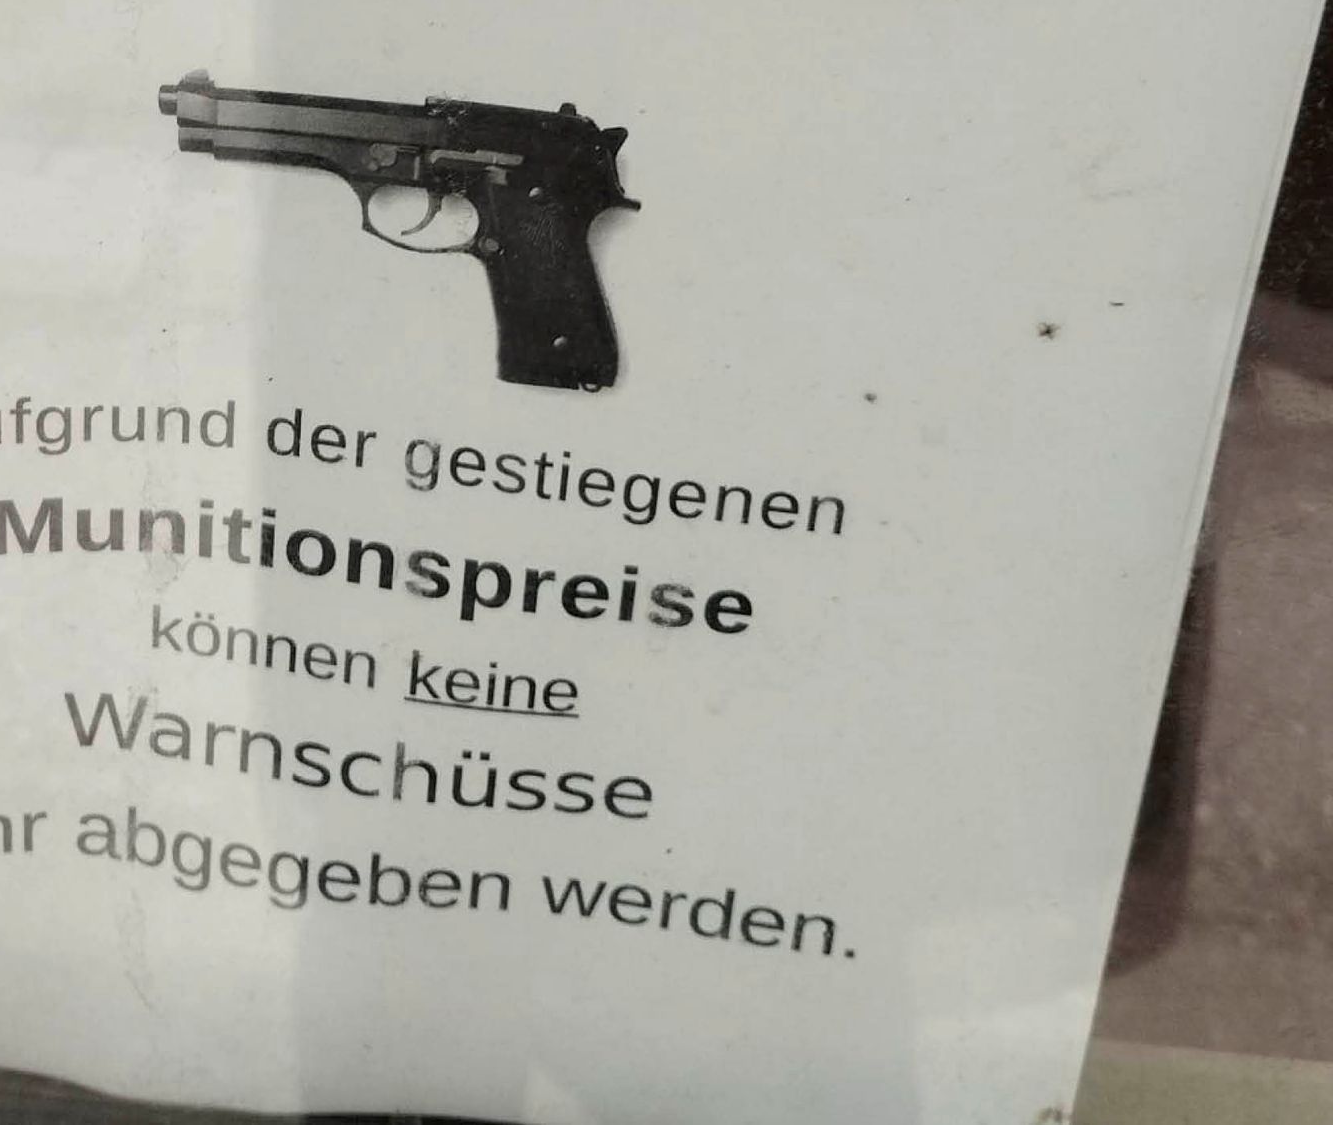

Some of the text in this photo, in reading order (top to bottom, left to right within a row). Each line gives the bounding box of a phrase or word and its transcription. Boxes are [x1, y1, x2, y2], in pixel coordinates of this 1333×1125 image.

[265, 406, 379, 470] der
[403, 435, 848, 538] gestiegenen
[149, 603, 581, 719] können keine
[62, 687, 656, 822] Warnschüsse
[75, 804, 513, 913] abgegeben
[540, 874, 859, 961] werden.
